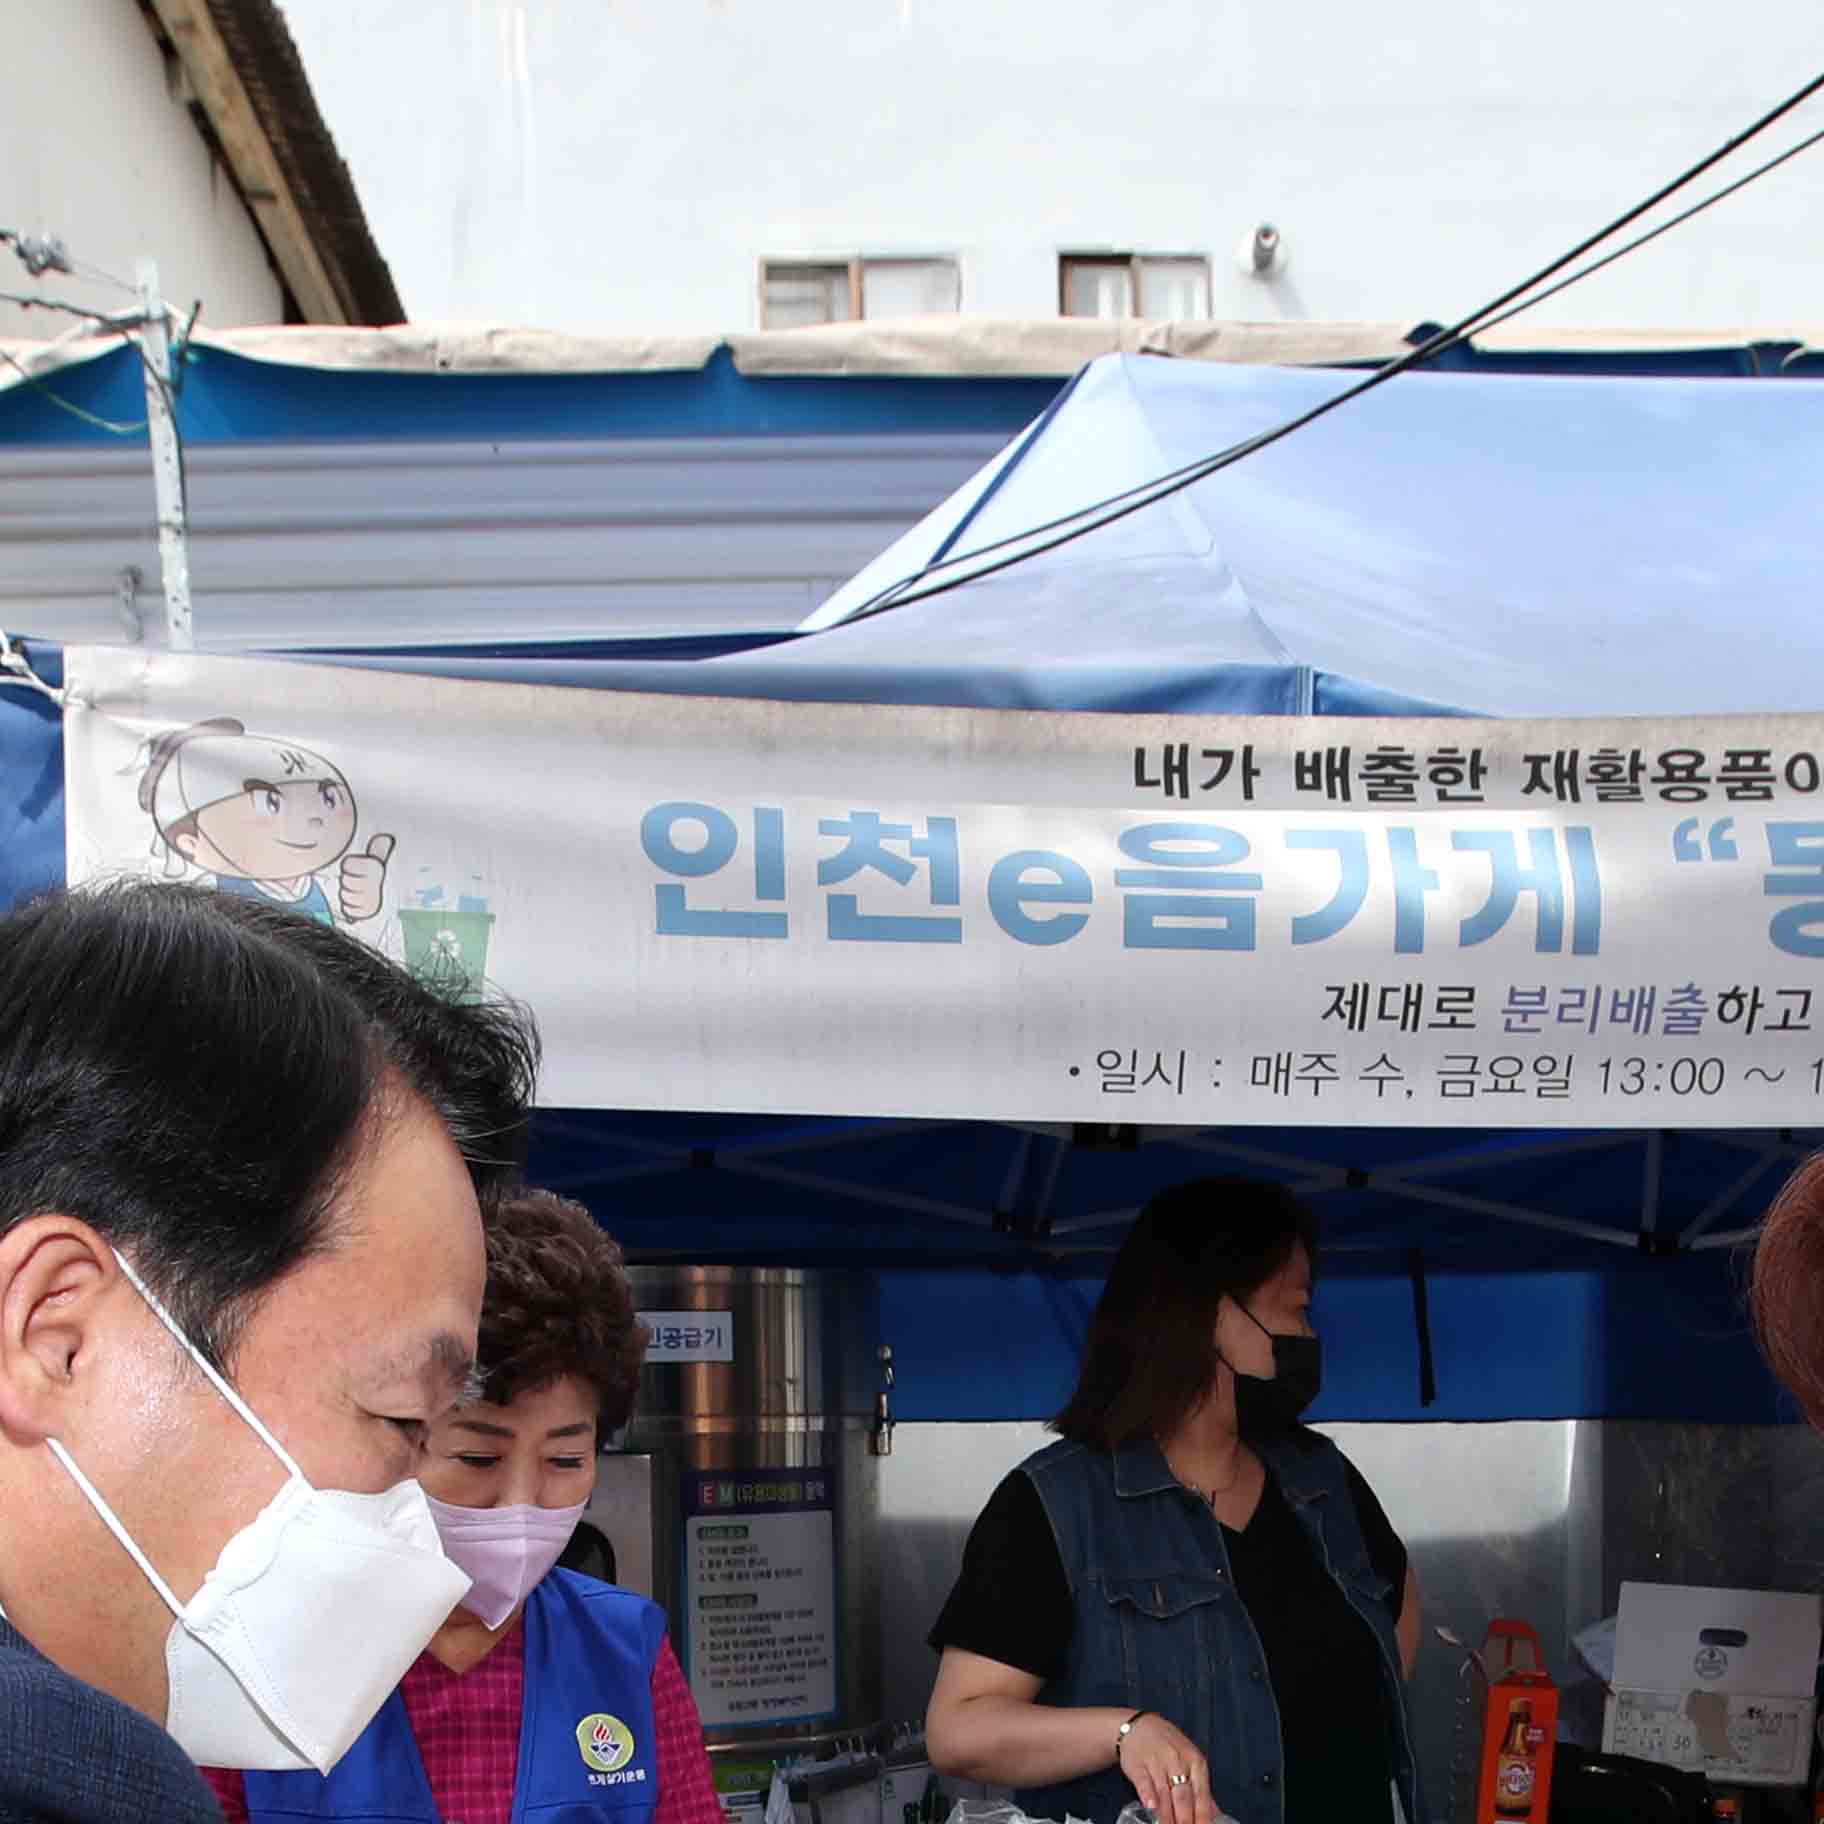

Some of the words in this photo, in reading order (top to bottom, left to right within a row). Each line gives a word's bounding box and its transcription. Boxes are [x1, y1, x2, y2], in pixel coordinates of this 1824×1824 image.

[1133, 743, 1261, 801] 내가
[1294, 744, 1488, 802] 배출한
[639, 800, 1603, 956] 인천e음가게
[1321, 981, 1478, 1033] 제대로
[1499, 982, 1813, 1035] 분리배출하고
[1250, 1052, 1341, 1098] 매주
[1358, 1051, 1414, 1099] 수,
[1436, 1054, 1575, 1100] 금요일
[1597, 1057, 1725, 1096] 13:00
